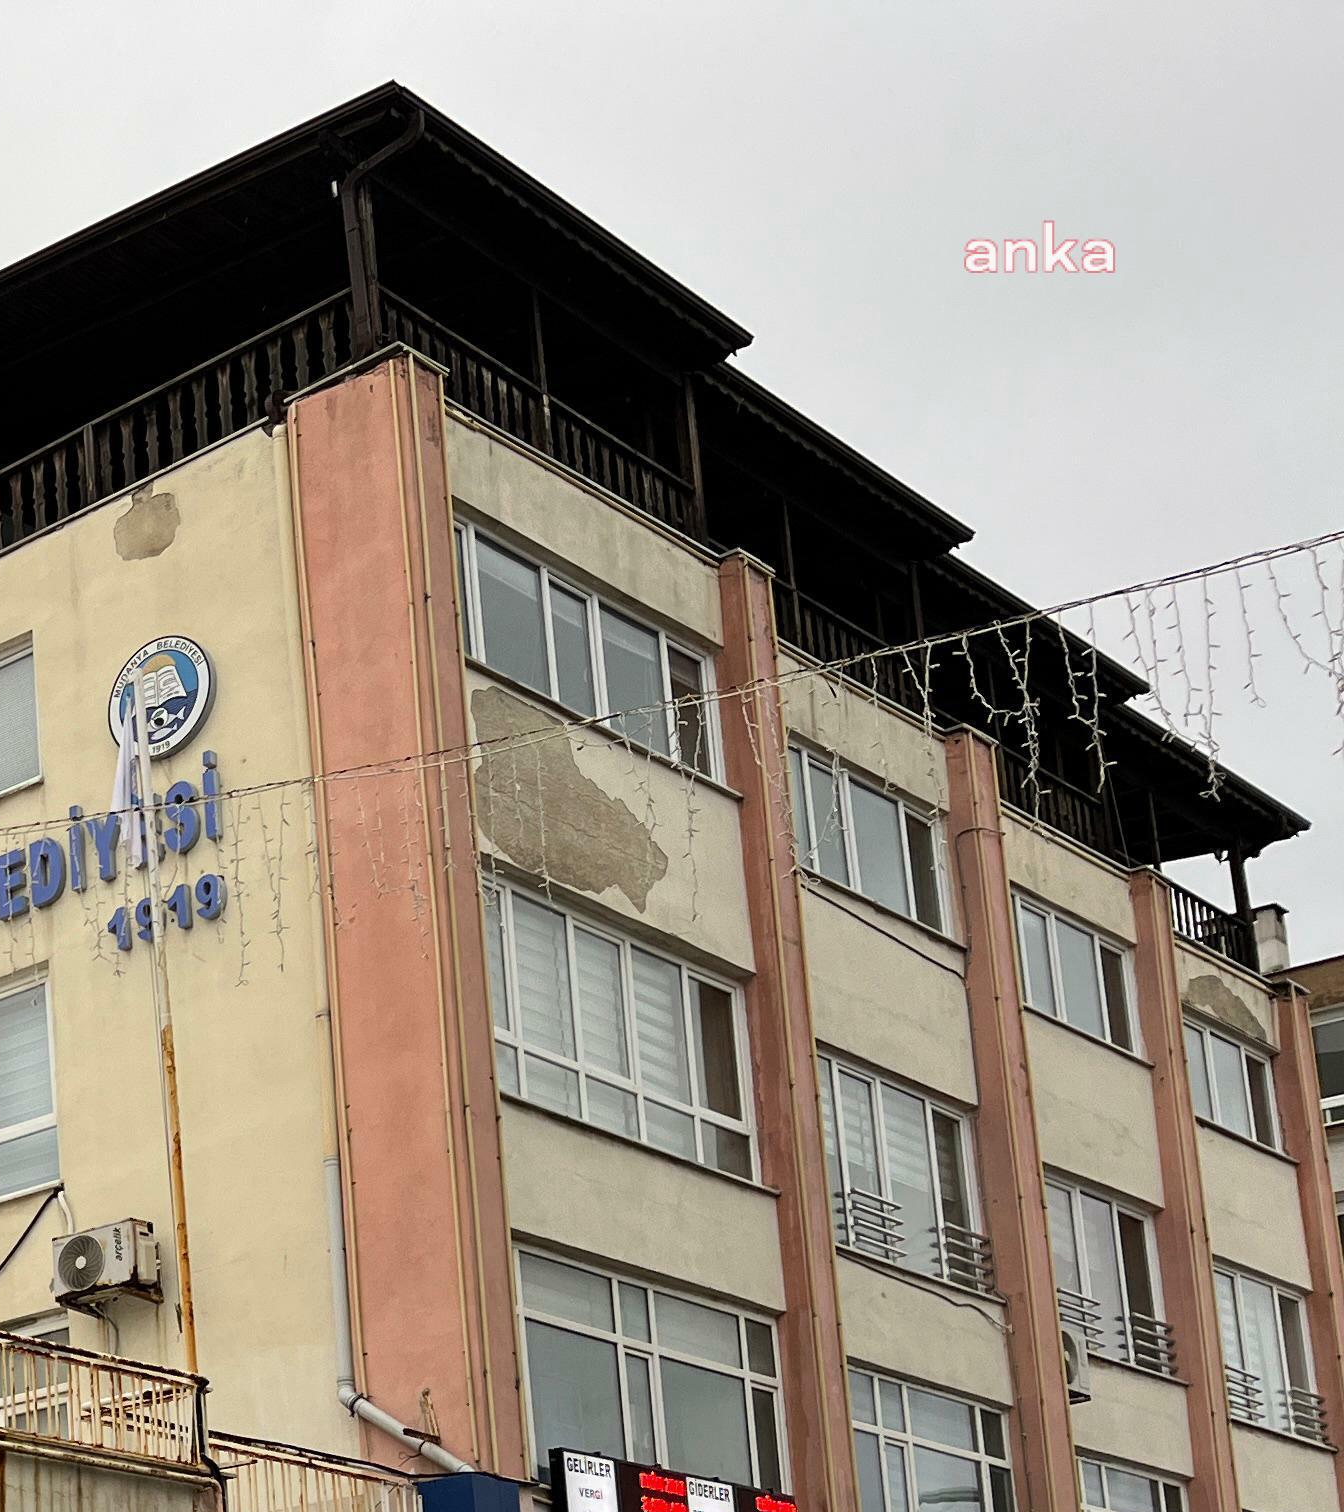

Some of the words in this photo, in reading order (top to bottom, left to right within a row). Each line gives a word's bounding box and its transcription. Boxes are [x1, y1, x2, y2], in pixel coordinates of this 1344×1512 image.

[114, 649, 149, 698] MUDANYA
[156, 639, 205, 666] BELEDİYESİ
[152, 740, 171, 753] 1919
[108, 874, 227, 951] 1919
[112, 1227, 123, 1262] arçelik
[566, 1457, 611, 1478] GELİRLER
[689, 1480, 730, 1502] GİDERLER
